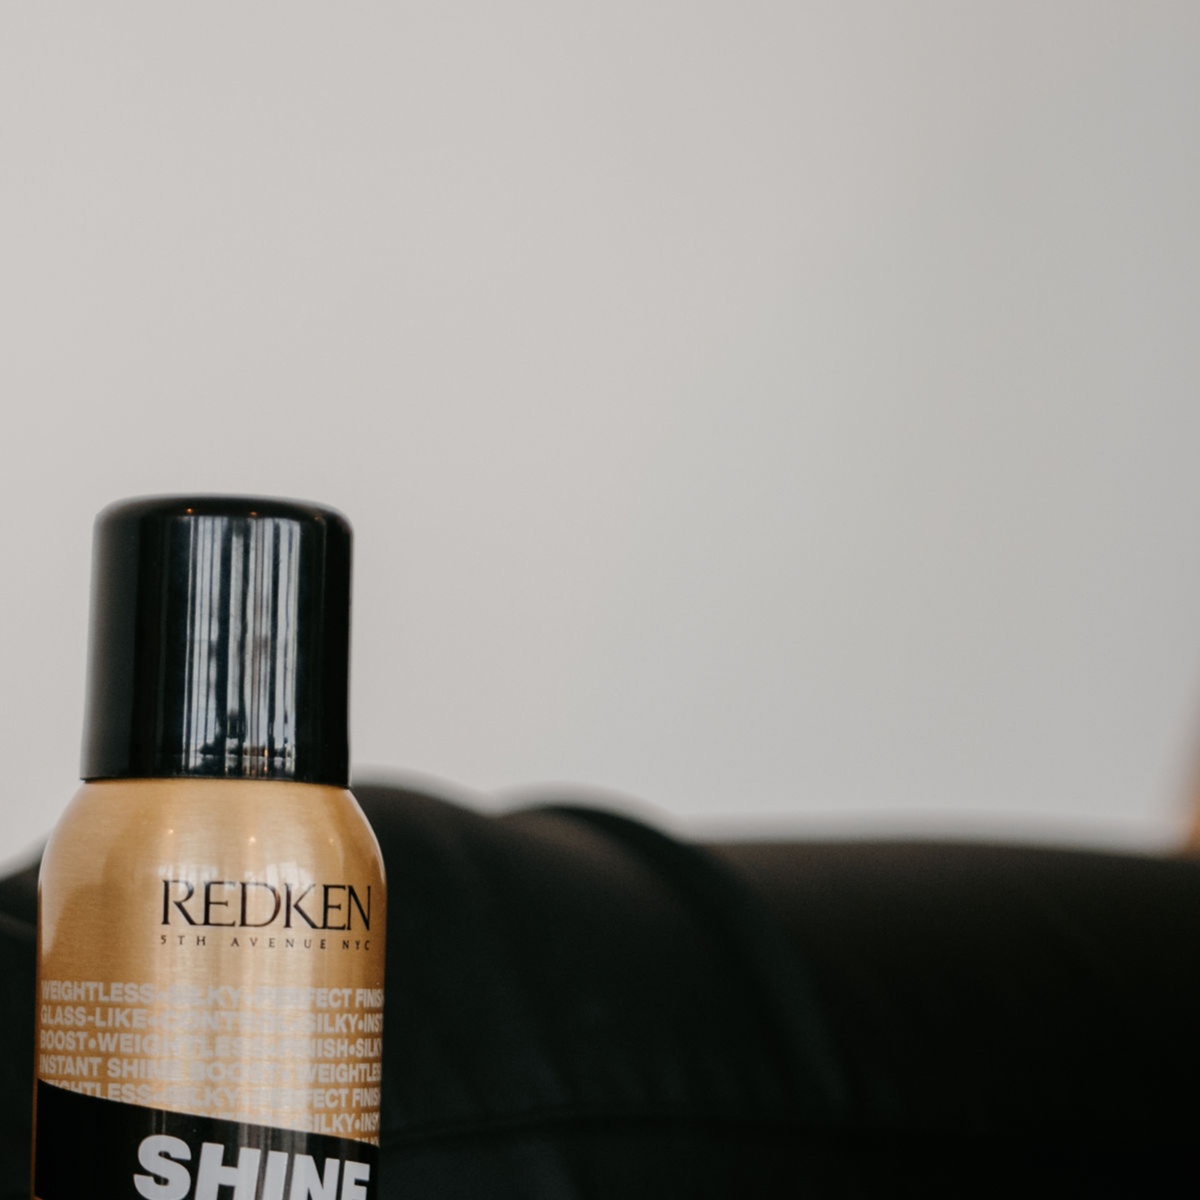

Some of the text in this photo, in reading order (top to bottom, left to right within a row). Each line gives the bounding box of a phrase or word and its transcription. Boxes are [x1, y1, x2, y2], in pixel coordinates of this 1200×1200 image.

[161, 879, 371, 931] REDKEN
[160, 935, 370, 951] 5TH AVENUE NYC
[355, 987, 384, 1009] FINIS
